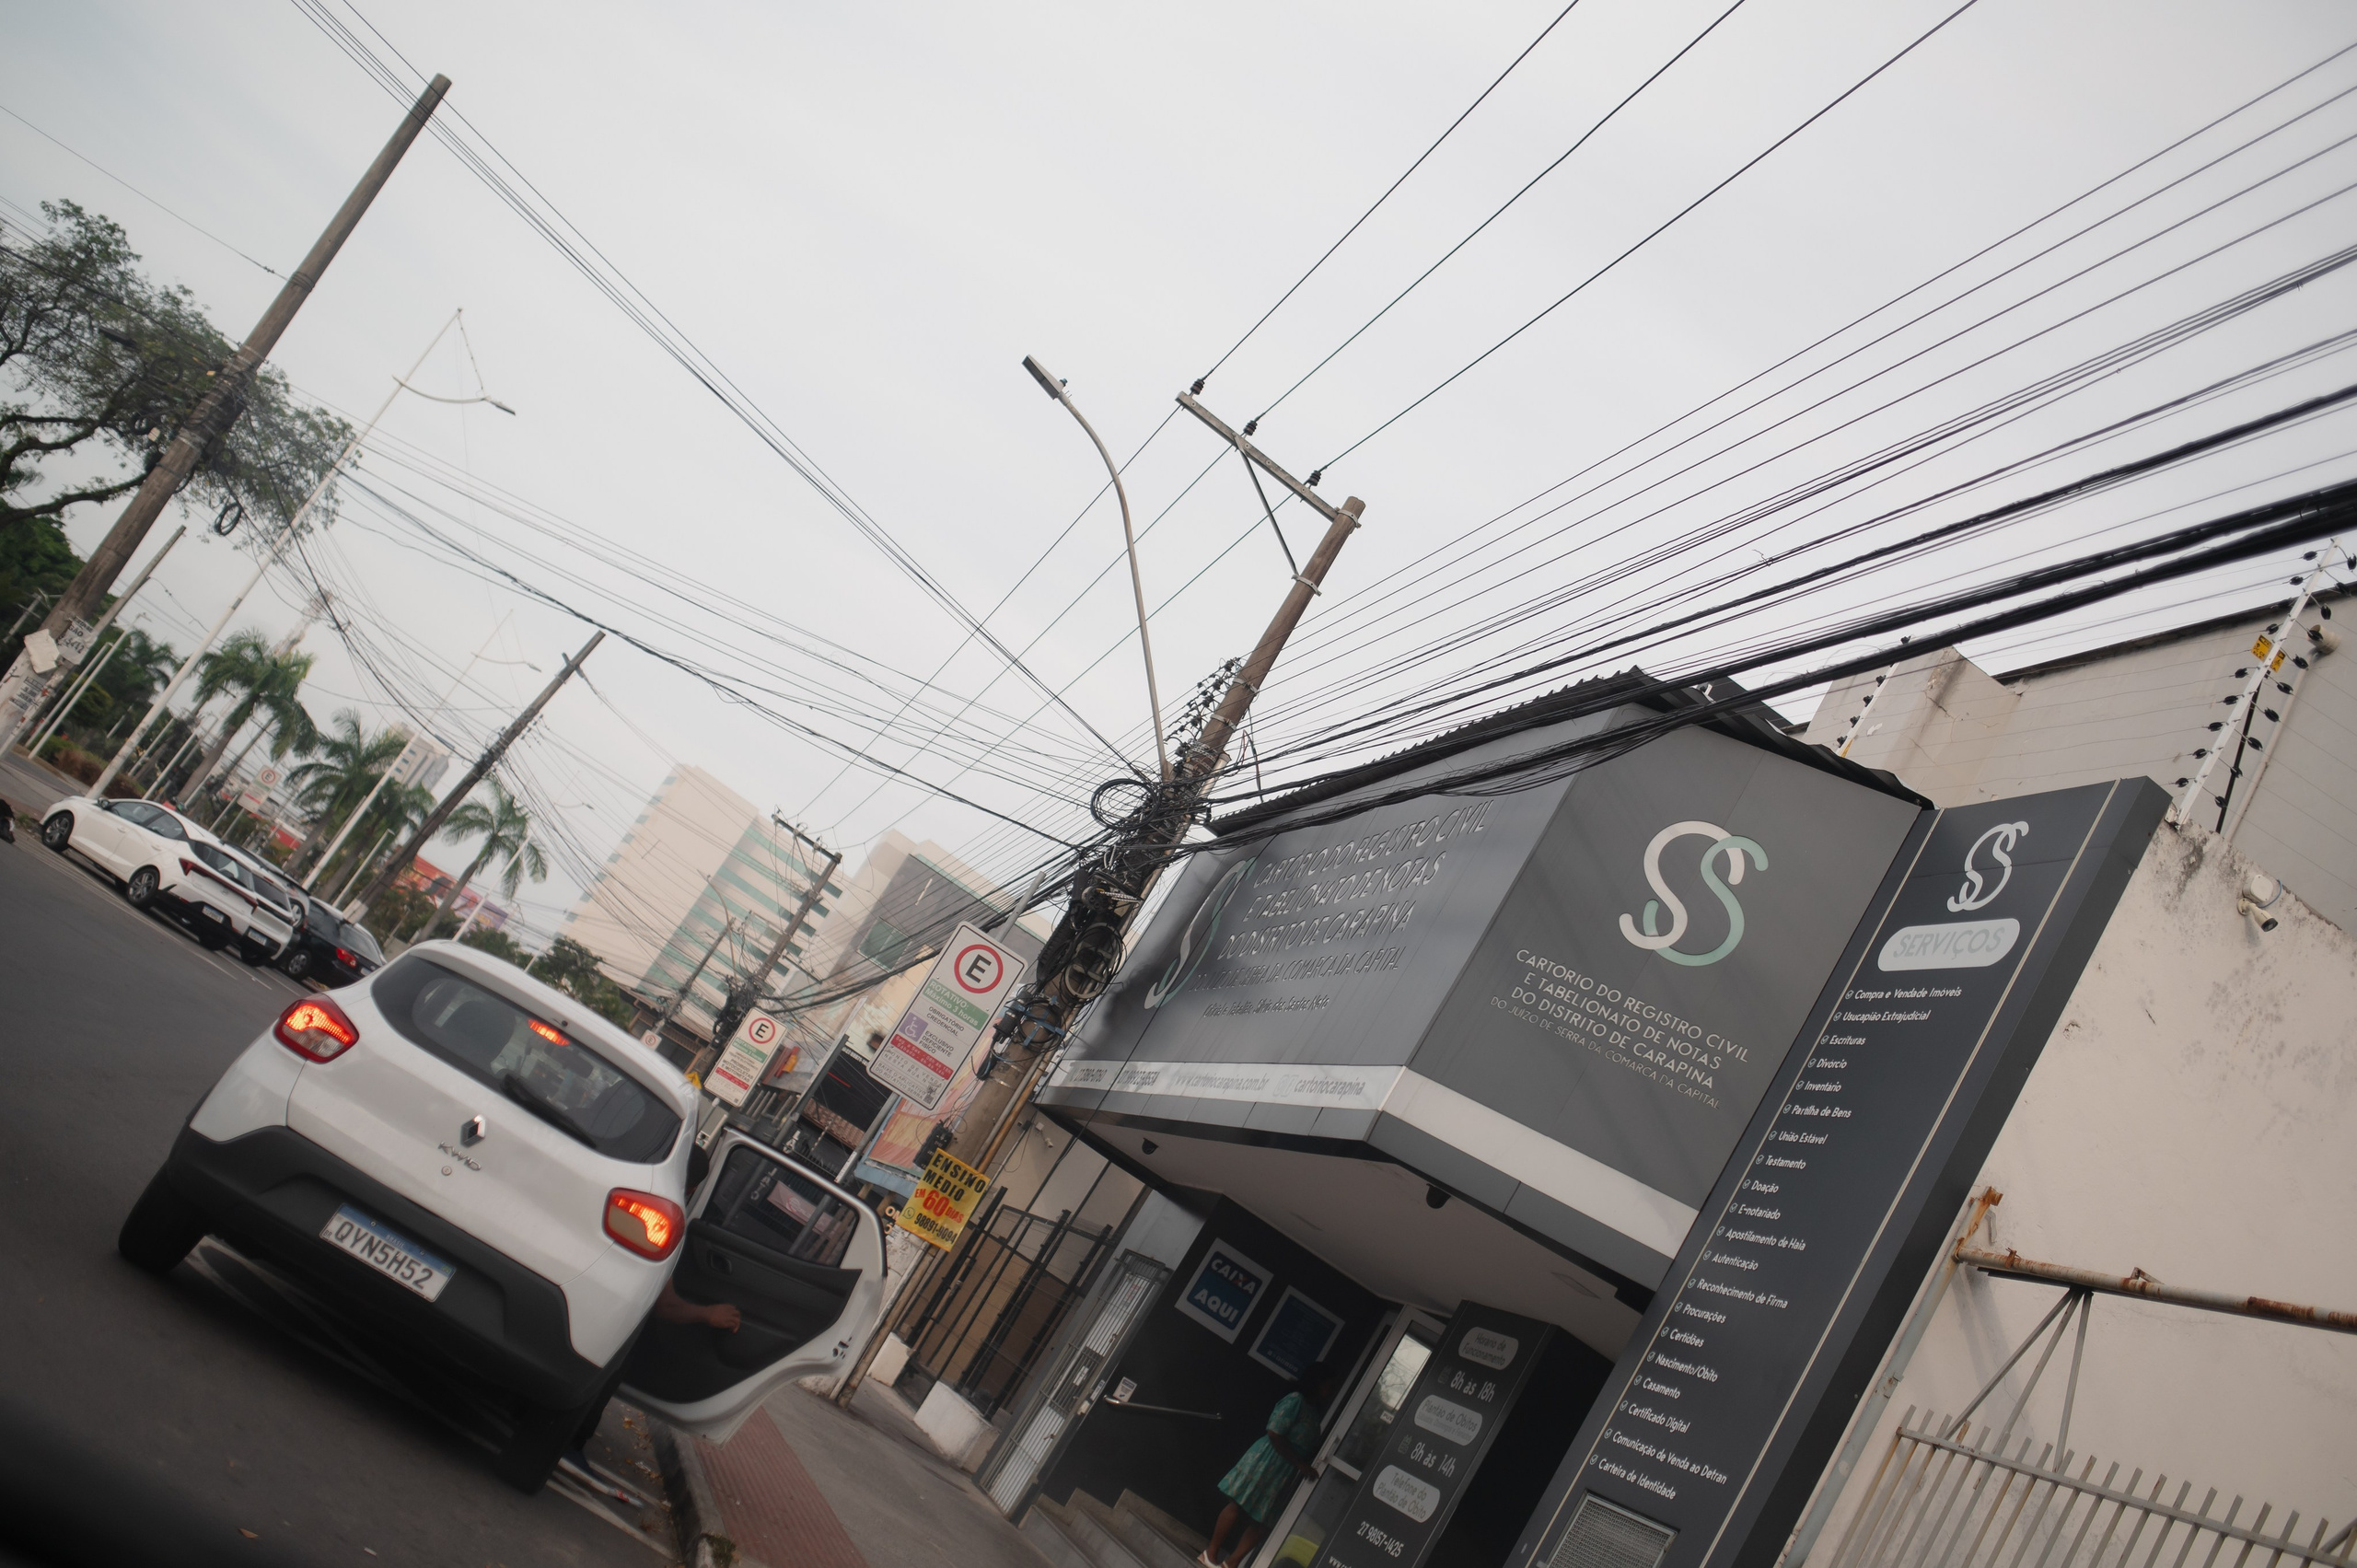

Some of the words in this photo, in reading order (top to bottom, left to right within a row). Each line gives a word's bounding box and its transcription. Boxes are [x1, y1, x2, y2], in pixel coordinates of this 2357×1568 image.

[1321, 841, 1354, 872] DO
[1347, 814, 1440, 865] REGISTRO
[1435, 799, 1494, 842] CIVIL
[1348, 867, 1383, 900] DE
[1372, 850, 1446, 895] NOTAS
[1217, 932, 1246, 960] DO
[1238, 920, 1306, 957] DISTRITO
[1297, 915, 1330, 947] DE
[1322, 900, 1416, 944] CARAPINA
[1893, 926, 2005, 960] SERVIÇOS
[966, 954, 992, 983] E
[1265, 962, 1285, 983] DA
[1283, 955, 1338, 981] COMARCA
[1334, 952, 1357, 975] DA
[1354, 946, 1407, 974] CAPITAL
[925, 987, 952, 1009] Máximo
[958, 1009, 979, 1026] horas
[1854, 990, 1884, 1002] Compra
[1929, 986, 1962, 997] Imóveis
[926, 1013, 958, 1037] CREDENCIAL
[928, 1006, 964, 1031] OBRIGATÓRIO
[1524, 972, 1536, 985] E
[1538, 978, 1641, 1032] TABELIONATO
[1646, 1026, 1665, 1044] DE
[1666, 1037, 1722, 1070] NOTAS
[1596, 983, 1622, 1003] DO
[1623, 996, 1702, 1040] REGISTRO
[1705, 1033, 1749, 1063] CIVIL
[1842, 1012, 1881, 1024] Usucapião
[1881, 1009, 1932, 1023] Extrajudicial
[755, 1023, 769, 1039] E
[924, 1030, 954, 1051] EXCLUSIVO
[1512, 987, 1537, 1005] DO
[1538, 999, 1607, 1038] DISTRITO
[1609, 1030, 1631, 1049] DE
[1633, 1043, 1713, 1089] CARAPINA
[1829, 1035, 1866, 1045] Escrituras
[922, 1035, 952, 1058] DEFICIENTE
[1490, 996, 1507, 1009] DO
[1538, 1018, 1553, 1031] DE
[1554, 1025, 1585, 1046] SERRA
[1587, 1040, 1602, 1054] DA
[1605, 1050, 1657, 1082] COMARCA
[1658, 1074, 1674, 1088] DA
[1677, 1083, 1721, 1109] CAPITAL
[885, 1053, 904, 1068] NESTA
[908, 1068, 920, 1078] RUA
[1817, 1058, 1847, 1069] Divórcio
[878, 1063, 891, 1074] BAIXE
[898, 1074, 925, 1096] APLICATIVO
[884, 1073, 907, 1089] ROTATIVO
[908, 1087, 923, 1100] SERRA
[922, 1071, 942, 1087] VENDA
[1294, 1076, 1366, 1100] cartoriocarapina
[1804, 1080, 1841, 1093] Inventário
[1791, 1105, 1818, 1116] Partilha
[1820, 1106, 1831, 1117] de
[1831, 1107, 1852, 1119] Bens
[1778, 1131, 1798, 1142] União
[1799, 1132, 1829, 1144] Estável
[437, 1141, 482, 1171] KWID
[1765, 1155, 1806, 1169] Testamento
[923, 1169, 965, 1202] MÉDIO
[933, 1153, 986, 1194] ENSINO
[1751, 1180, 1779, 1195] Doação
[914, 1189, 926, 1198] EM
[923, 1190, 950, 1217] 60
[945, 1206, 965, 1224] DIAS
[1738, 1204, 1781, 1220] E-notariado
[323, 1229, 332, 1238] BR
[385, 1235, 405, 1249] BRASIL
[1725, 1228, 1777, 1246] Apostilamento
[1778, 1237, 1789, 1248] de
[1788, 1238, 1806, 1251] Haia
[1712, 1253, 1759, 1272] Autenticação
[1211, 1258, 1259, 1295] CAIXA
[1193, 1288, 1239, 1323] AQUI
[1697, 1278, 1755, 1301] Reconhecimento
[1755, 1293, 1767, 1305] de
[1765, 1294, 1789, 1309] Firma
[1682, 1304, 1726, 1324] Procurações
[1669, 1329, 1704, 1348] Certidões
[1451, 1370, 1466, 1390] 8h
[1463, 1378, 1477, 1395] às
[1477, 1380, 1496, 1403] 18h
[1643, 1377, 1681, 1400] Casamento
[1422, 1400, 1446, 1419] Plantão
[1446, 1409, 1455, 1423] de
[1628, 1403, 1666, 1425] Certificado
[1665, 1416, 1691, 1434] Digital
[1411, 1442, 1425, 1462] 8h
[1422, 1449, 1436, 1468] às
[1438, 1454, 1456, 1478] 14h
[1612, 1431, 1656, 1458] Comunicação
[1656, 1448, 1666, 1462] de
[1666, 1452, 1689, 1470] Venda
[1689, 1464, 1700, 1475] ao
[1700, 1465, 1727, 1485] Detran
[1391, 1473, 1418, 1493] Telefone
[1418, 1488, 1427, 1501] do
[1598, 1458, 1627, 1479] Carteira
[1626, 1470, 1637, 1482] de
[1637, 1473, 1677, 1500] Identidade
[1377, 1481, 1399, 1504] Plantão
[1399, 1494, 1408, 1508] de
[1356, 1521, 1370, 1537] 27
[1366, 1527, 1404, 1558] 98157-1425
